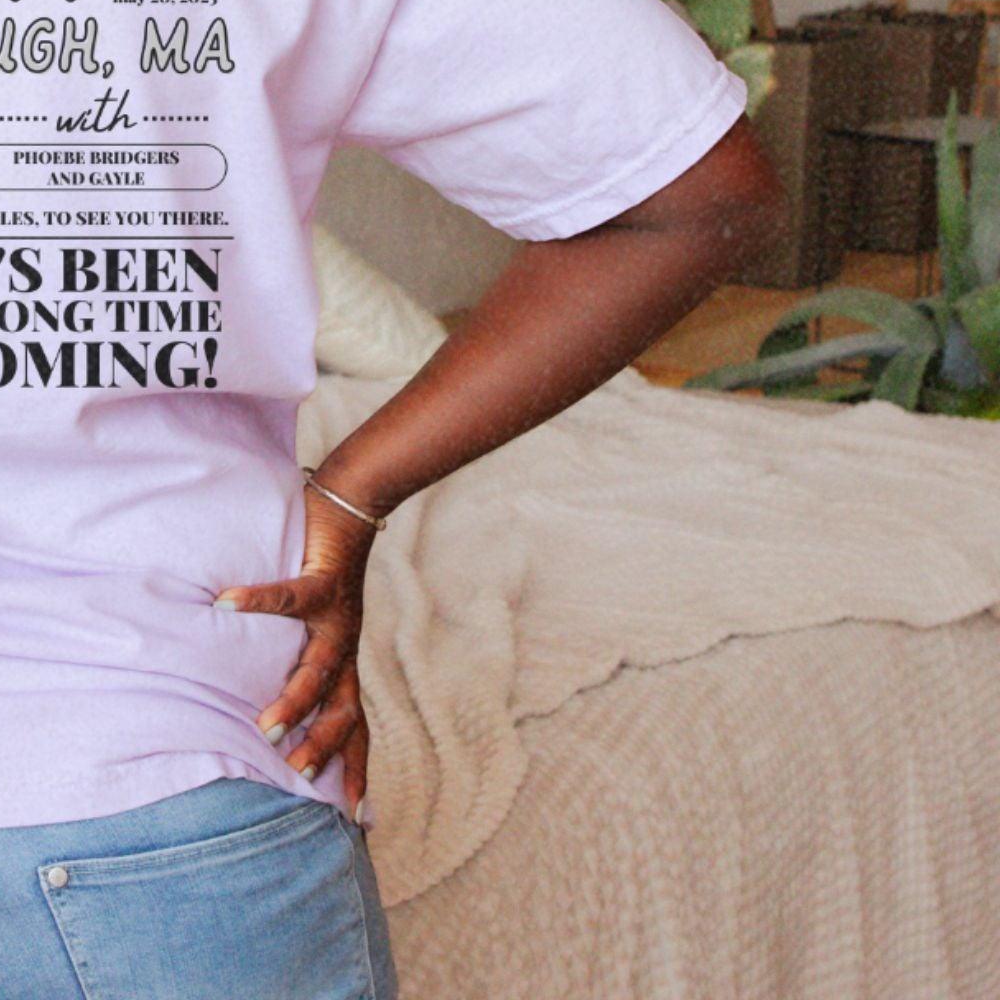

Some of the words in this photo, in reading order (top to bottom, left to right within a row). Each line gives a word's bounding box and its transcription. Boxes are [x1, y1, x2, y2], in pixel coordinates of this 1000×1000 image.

[139, 16, 236, 75] MA
[55, 86, 138, 133] with
[13, 151, 86, 165] PHOEBE
[90, 150, 180, 165] BRIDGERS
[46, 171, 87, 186] AND
[88, 171, 145, 186] GAYLE
[43, 211, 72, 226] TO
[75, 211, 111, 226] SEE
[115, 211, 154, 226] YOU
[158, 210, 230, 226] THERE.
[59, 247, 223, 293] BEEN
[105, 299, 223, 333] TIME
